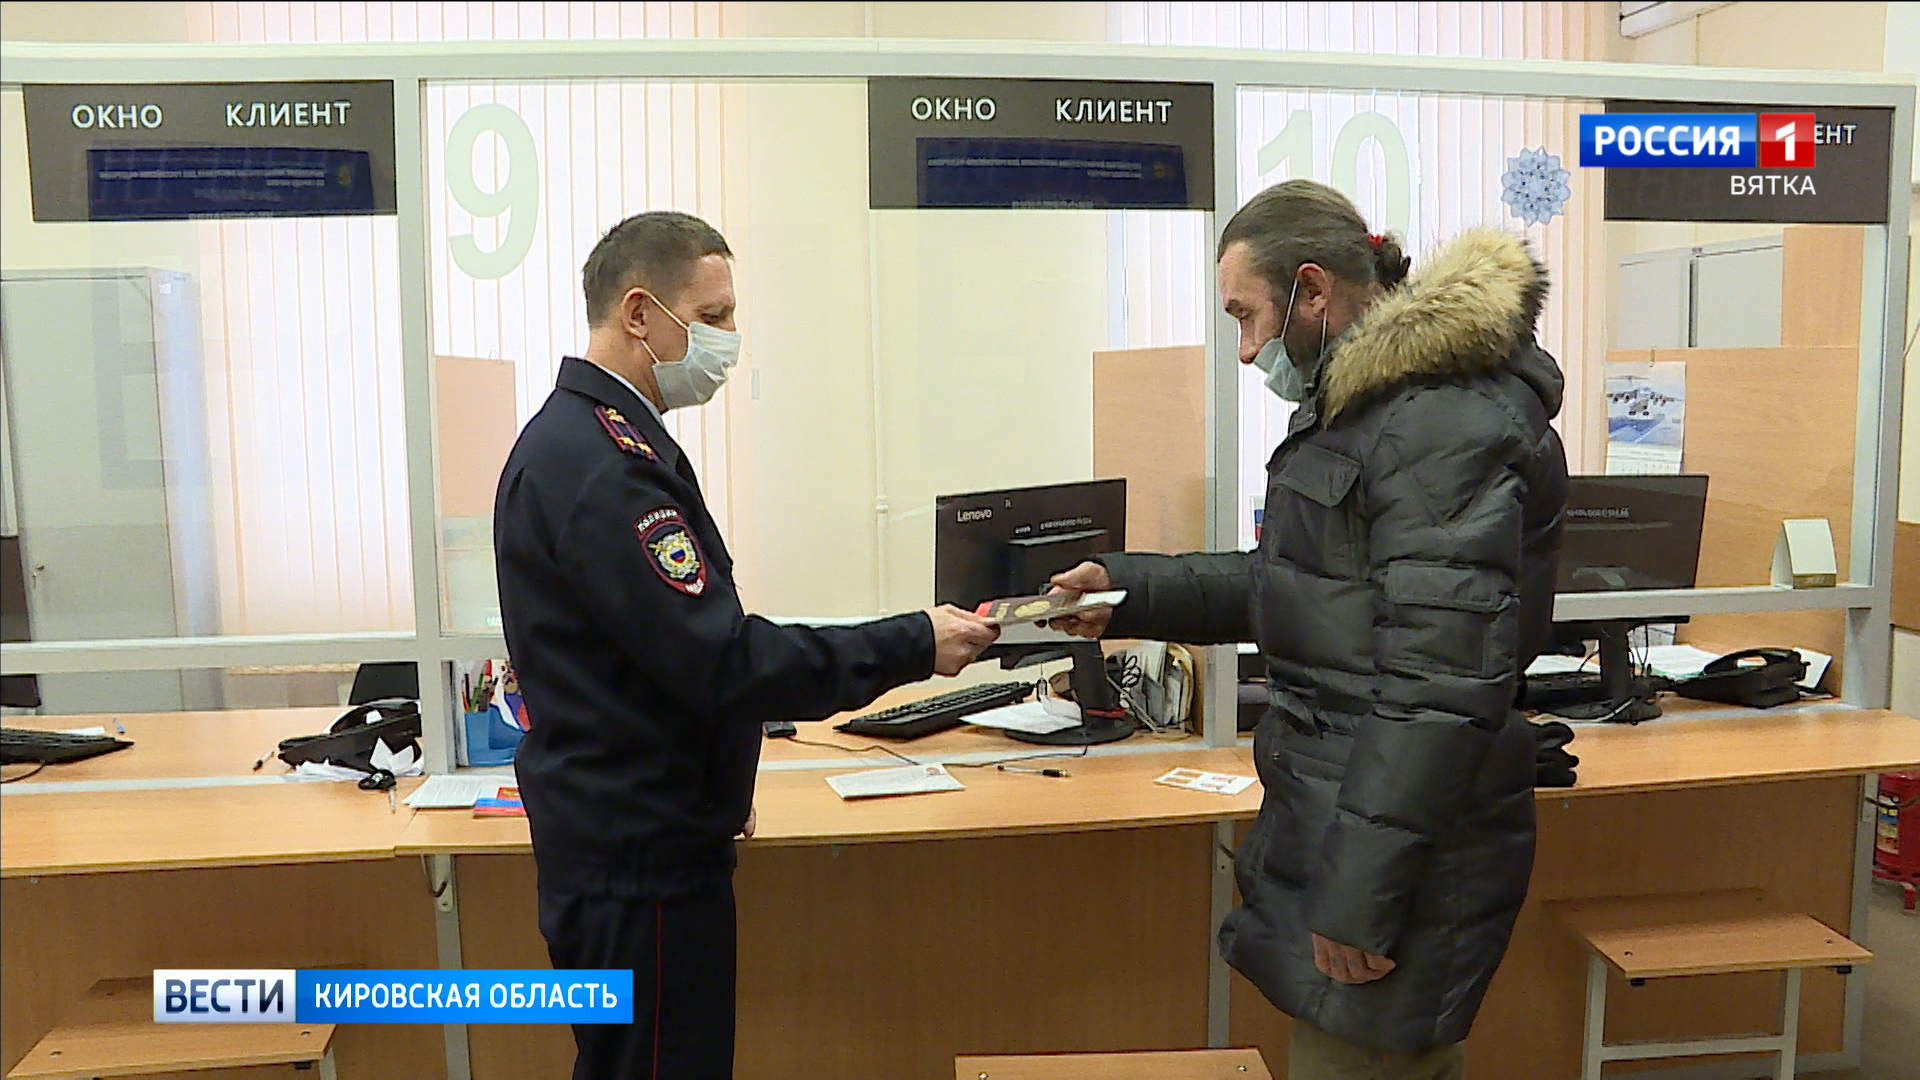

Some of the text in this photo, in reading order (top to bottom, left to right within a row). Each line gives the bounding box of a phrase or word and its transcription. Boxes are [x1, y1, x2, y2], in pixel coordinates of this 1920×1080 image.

[72, 101, 351, 129] ОКНО КЛИЕНТ
[911, 97, 1172, 124] ОКНО КЛИЕНТ
[1814, 124, 1857, 144] ЕНТ
[1257, 110, 1410, 240] 10
[445, 103, 540, 280] 9
[957, 509, 993, 522] Lenovo
